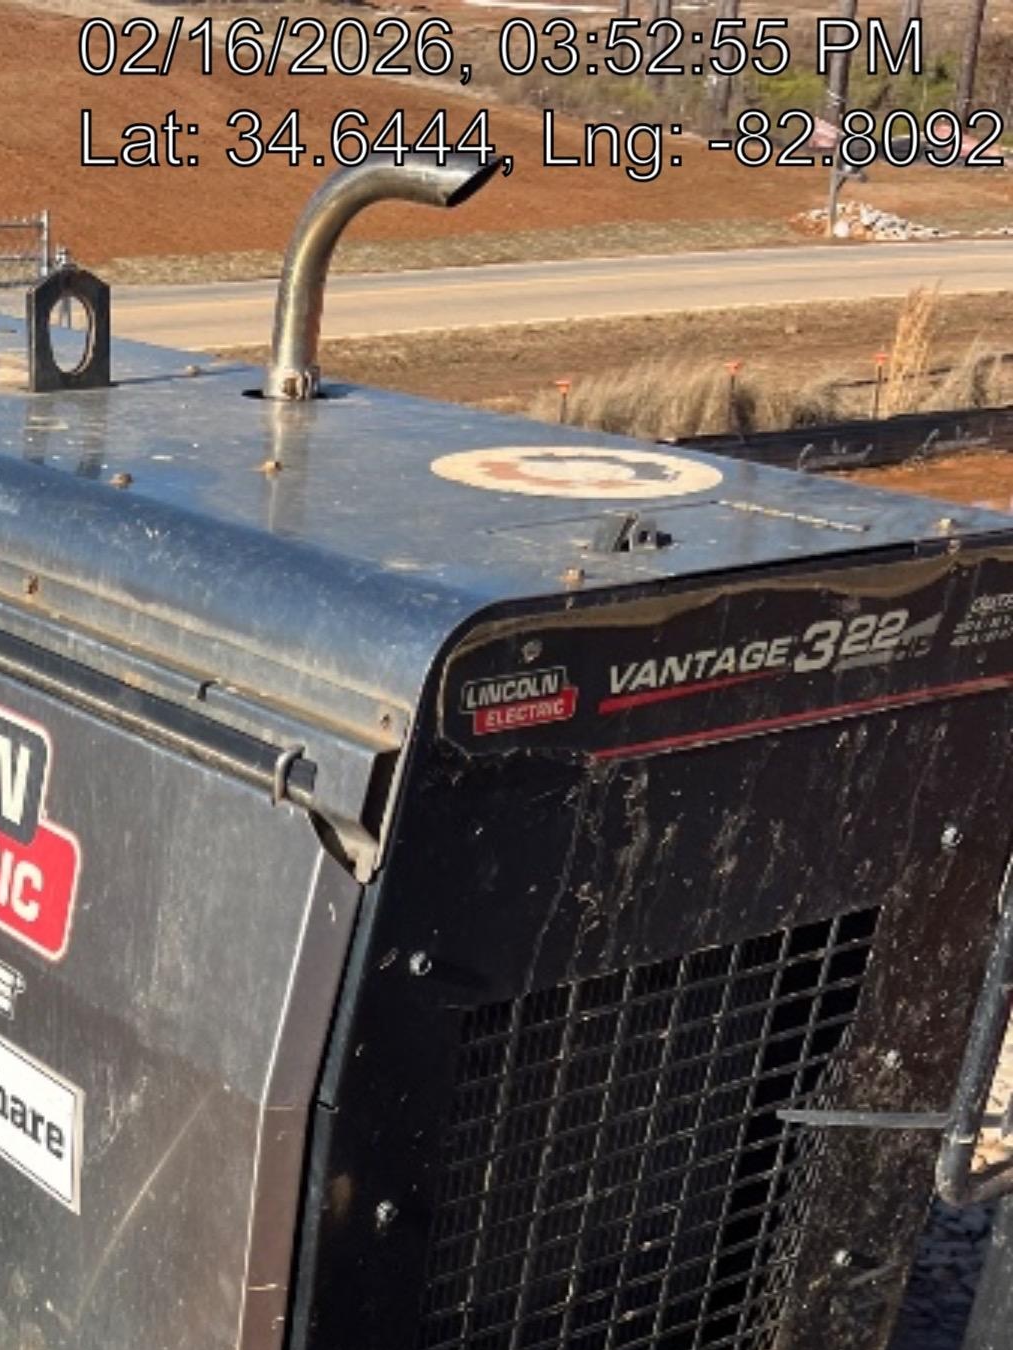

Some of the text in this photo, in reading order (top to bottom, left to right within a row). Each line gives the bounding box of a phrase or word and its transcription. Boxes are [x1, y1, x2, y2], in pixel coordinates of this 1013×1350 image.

[608, 608, 909, 695] VANTAGE 322
[466, 673, 559, 709] LINCOLN
[485, 697, 565, 728] ELECTRIC
